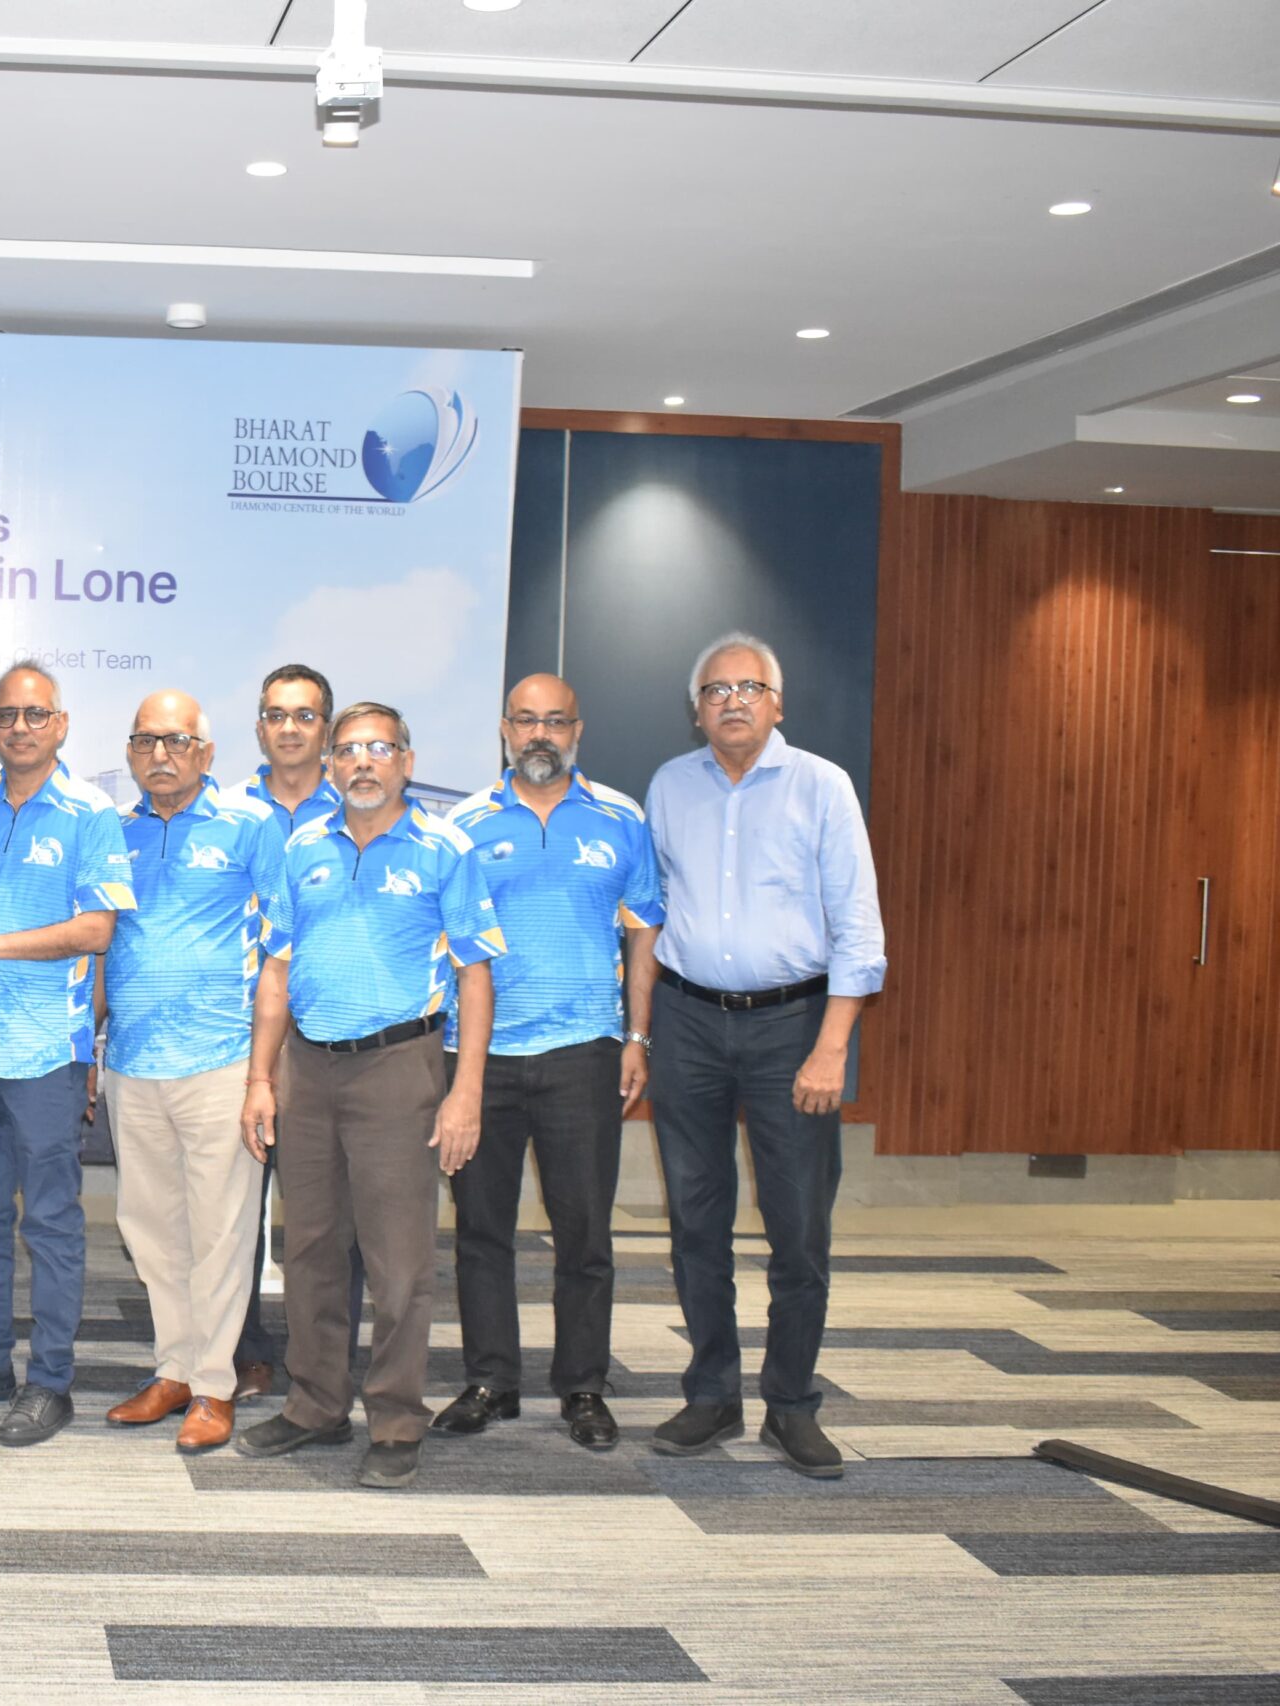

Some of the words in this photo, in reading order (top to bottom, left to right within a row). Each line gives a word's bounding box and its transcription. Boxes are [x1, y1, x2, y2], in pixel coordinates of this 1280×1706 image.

[234, 417, 332, 442] BHARAT
[234, 444, 357, 469] DIAMOND
[232, 470, 328, 494] BOURSE
[230, 500, 282, 513] DIAMOND
[283, 502, 324, 515] CENTRE
[327, 503, 341, 515] OF
[343, 504, 365, 516] THE
[366, 505, 406, 517] WORLD
[54, 558, 178, 605] Lone
[91, 649, 152, 670] Team
